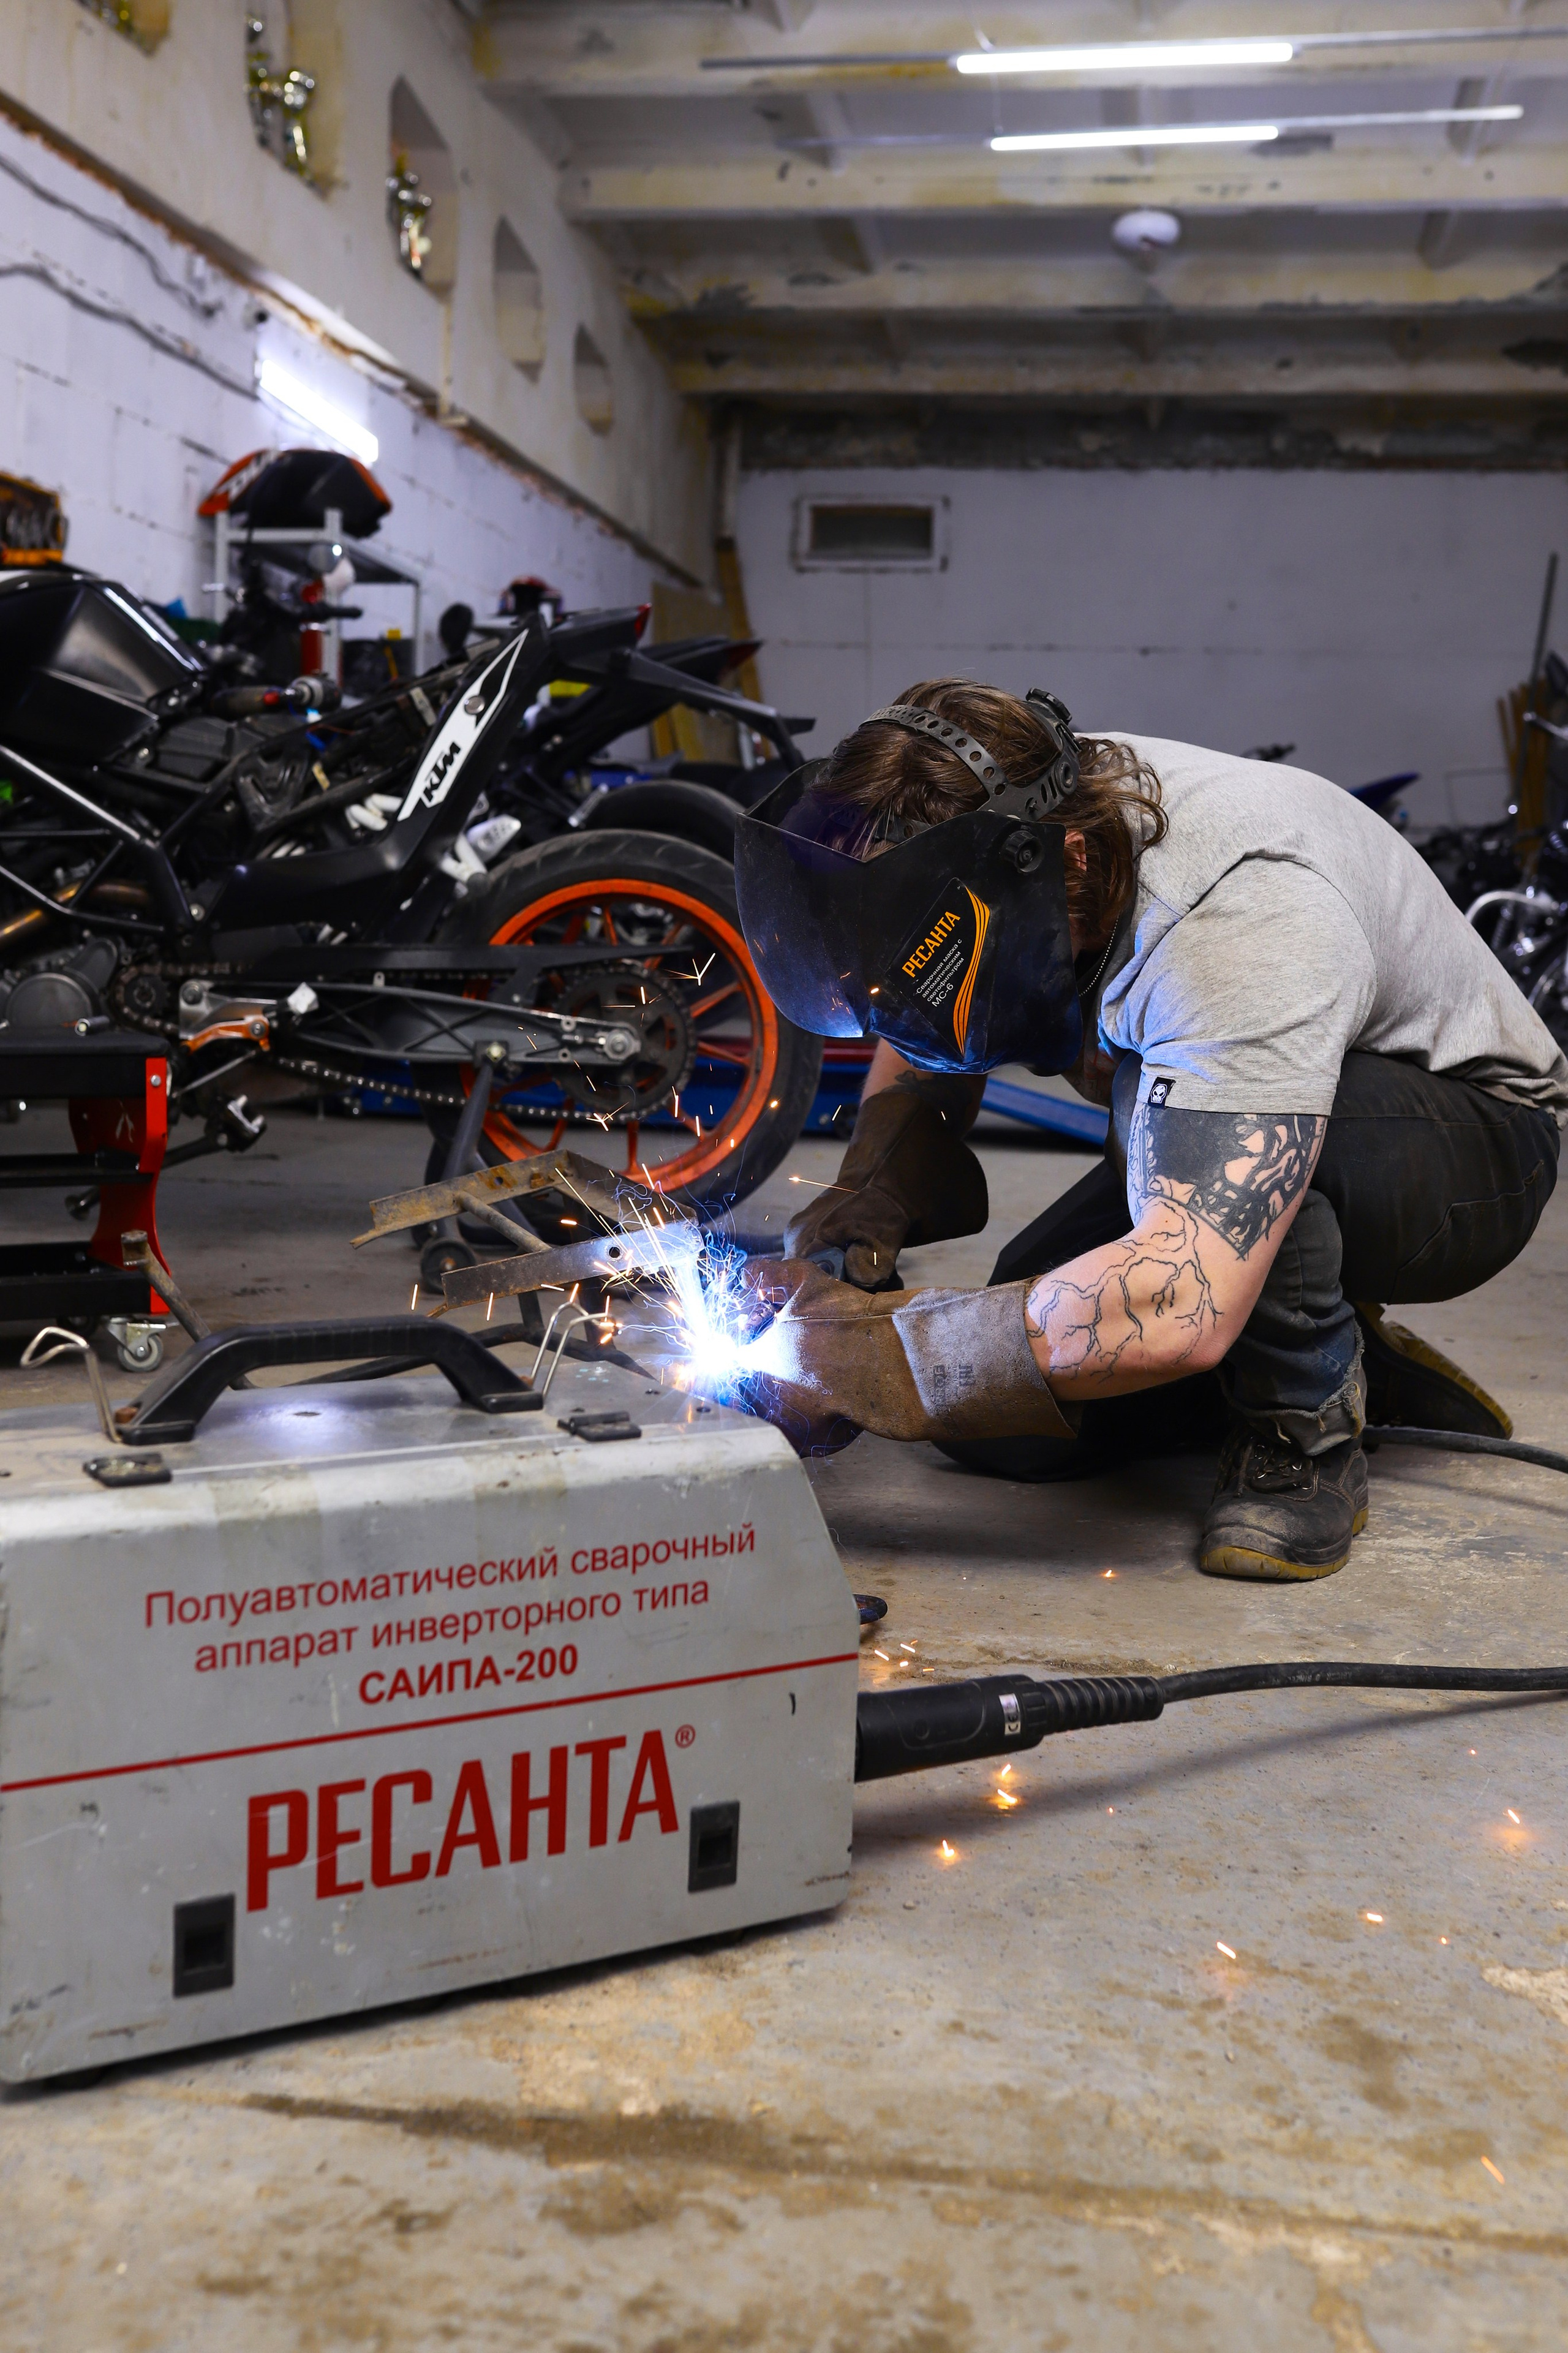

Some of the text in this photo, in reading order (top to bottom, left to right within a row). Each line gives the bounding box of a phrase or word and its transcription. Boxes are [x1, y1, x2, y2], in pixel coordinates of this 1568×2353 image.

[423, 741, 461, 802] KTM
[902, 911, 960, 978] РЕСАНТА
[916, 962, 944, 994] Сварочная
[943, 943, 959, 962] маска
[922, 951, 961, 998] автоматическим
[927, 957, 965, 1003] светофильтром
[932, 983, 954, 1007] МС-6
[145, 1522, 755, 1628] Полуавтоматический сварочный
[194, 1580, 709, 1673] аппарат инверторного типа
[358, 1643, 578, 1705] САИПА-200
